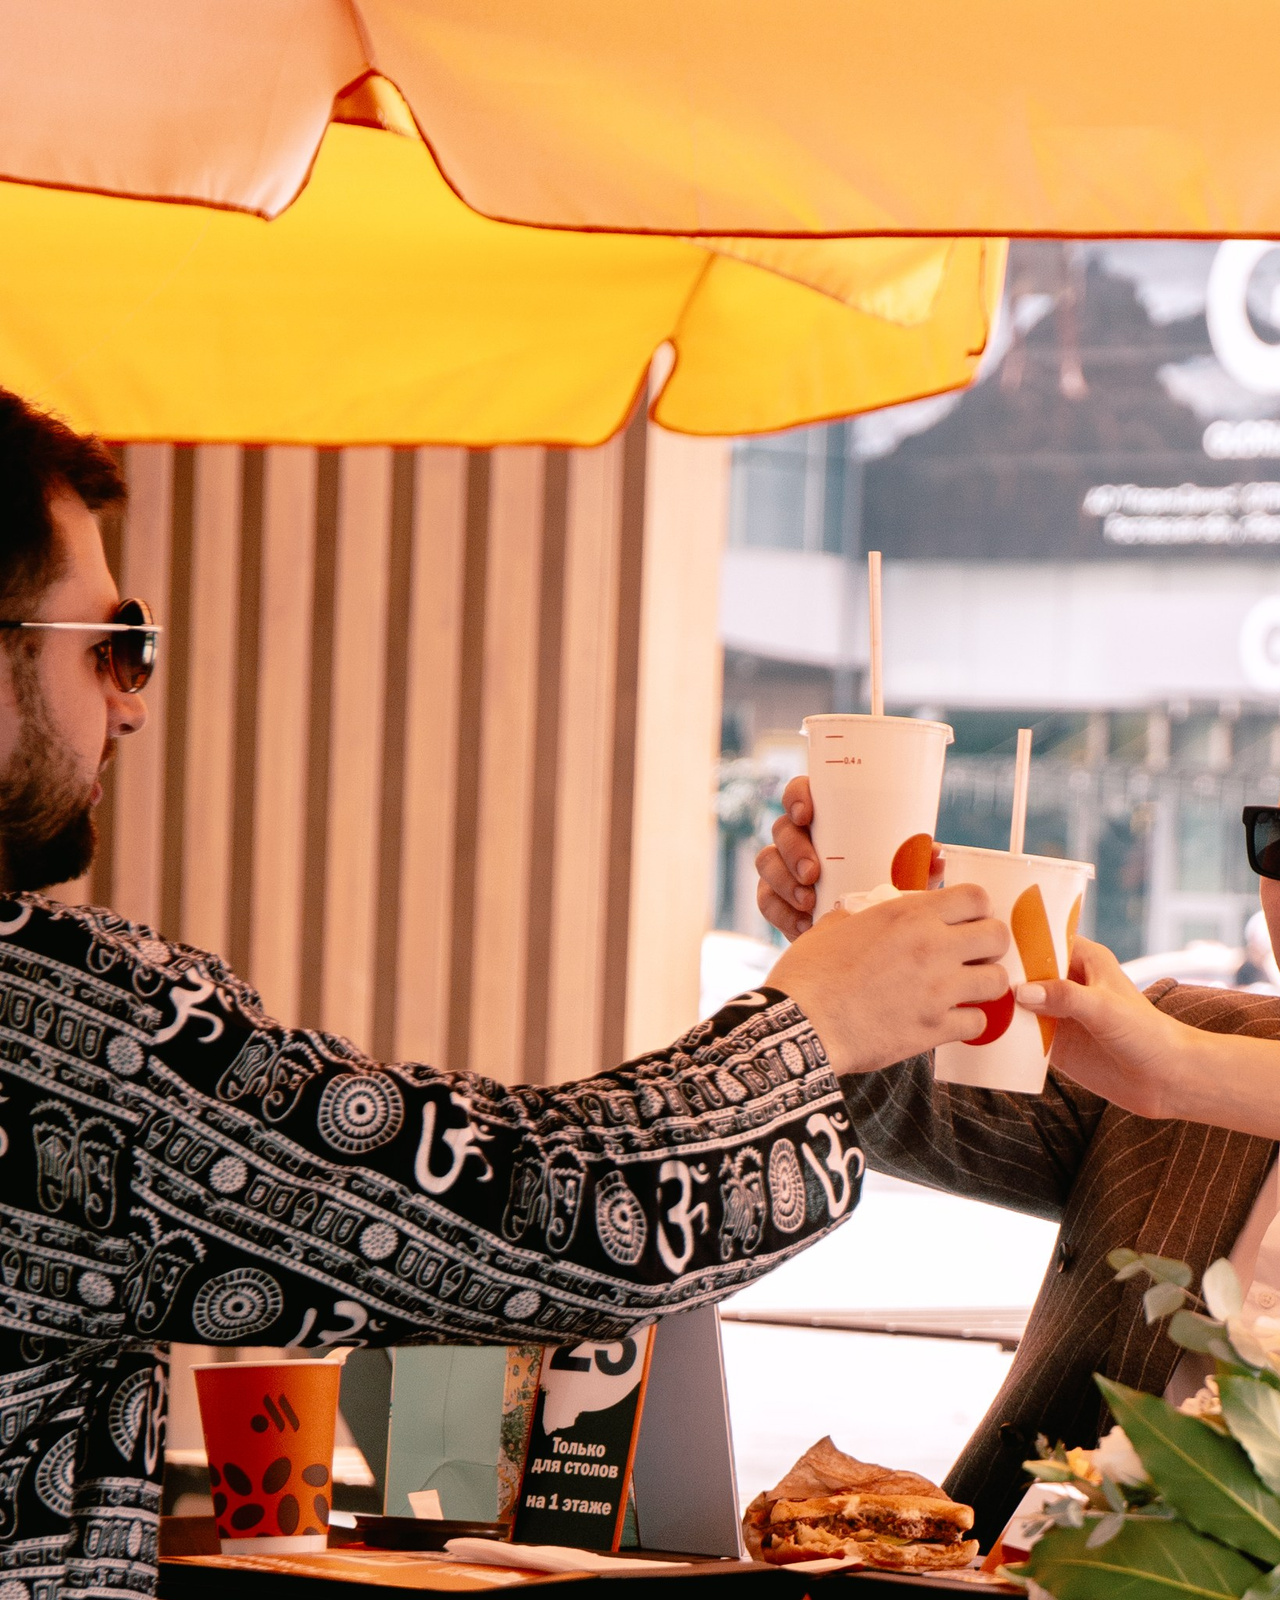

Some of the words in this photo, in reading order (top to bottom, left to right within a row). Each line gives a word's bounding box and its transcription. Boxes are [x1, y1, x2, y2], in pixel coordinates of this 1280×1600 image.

[552, 1436, 606, 1458] Только
[531, 1458, 562, 1475] для
[563, 1461, 619, 1478] столов
[525, 1494, 546, 1509] на
[548, 1493, 559, 1511] 1
[561, 1498, 612, 1515] этаже
